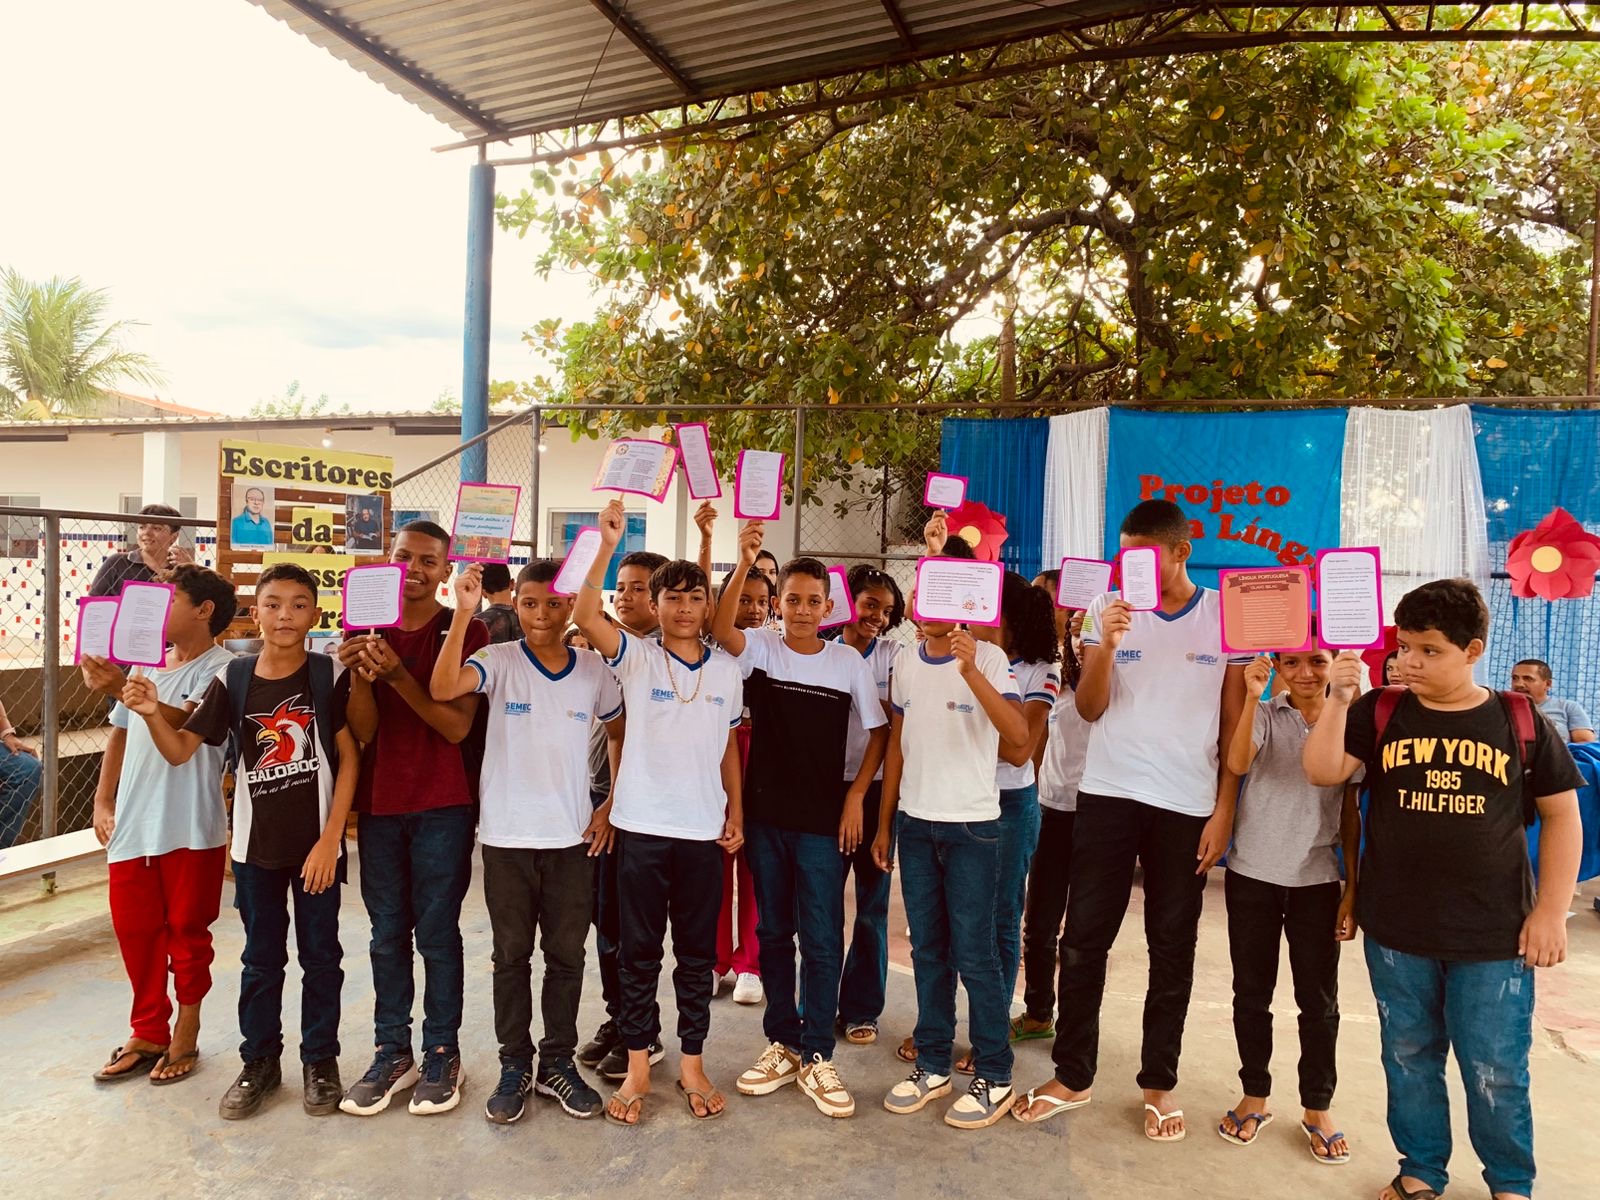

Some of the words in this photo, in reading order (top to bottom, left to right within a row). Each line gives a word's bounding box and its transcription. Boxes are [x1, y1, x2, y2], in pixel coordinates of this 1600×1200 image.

[222, 447, 392, 490] Escritores
[1138, 474, 1291, 513] Projeto
[293, 517, 332, 543] da
[650, 687, 675, 698] SEMEC
[504, 702, 532, 711] SEMEC
[1382, 738, 1438, 773] NEW
[1441, 738, 1511, 786] YORK
[1424, 769, 1463, 790] 1985
[1397, 789, 1486, 814] T.HILFIGER
